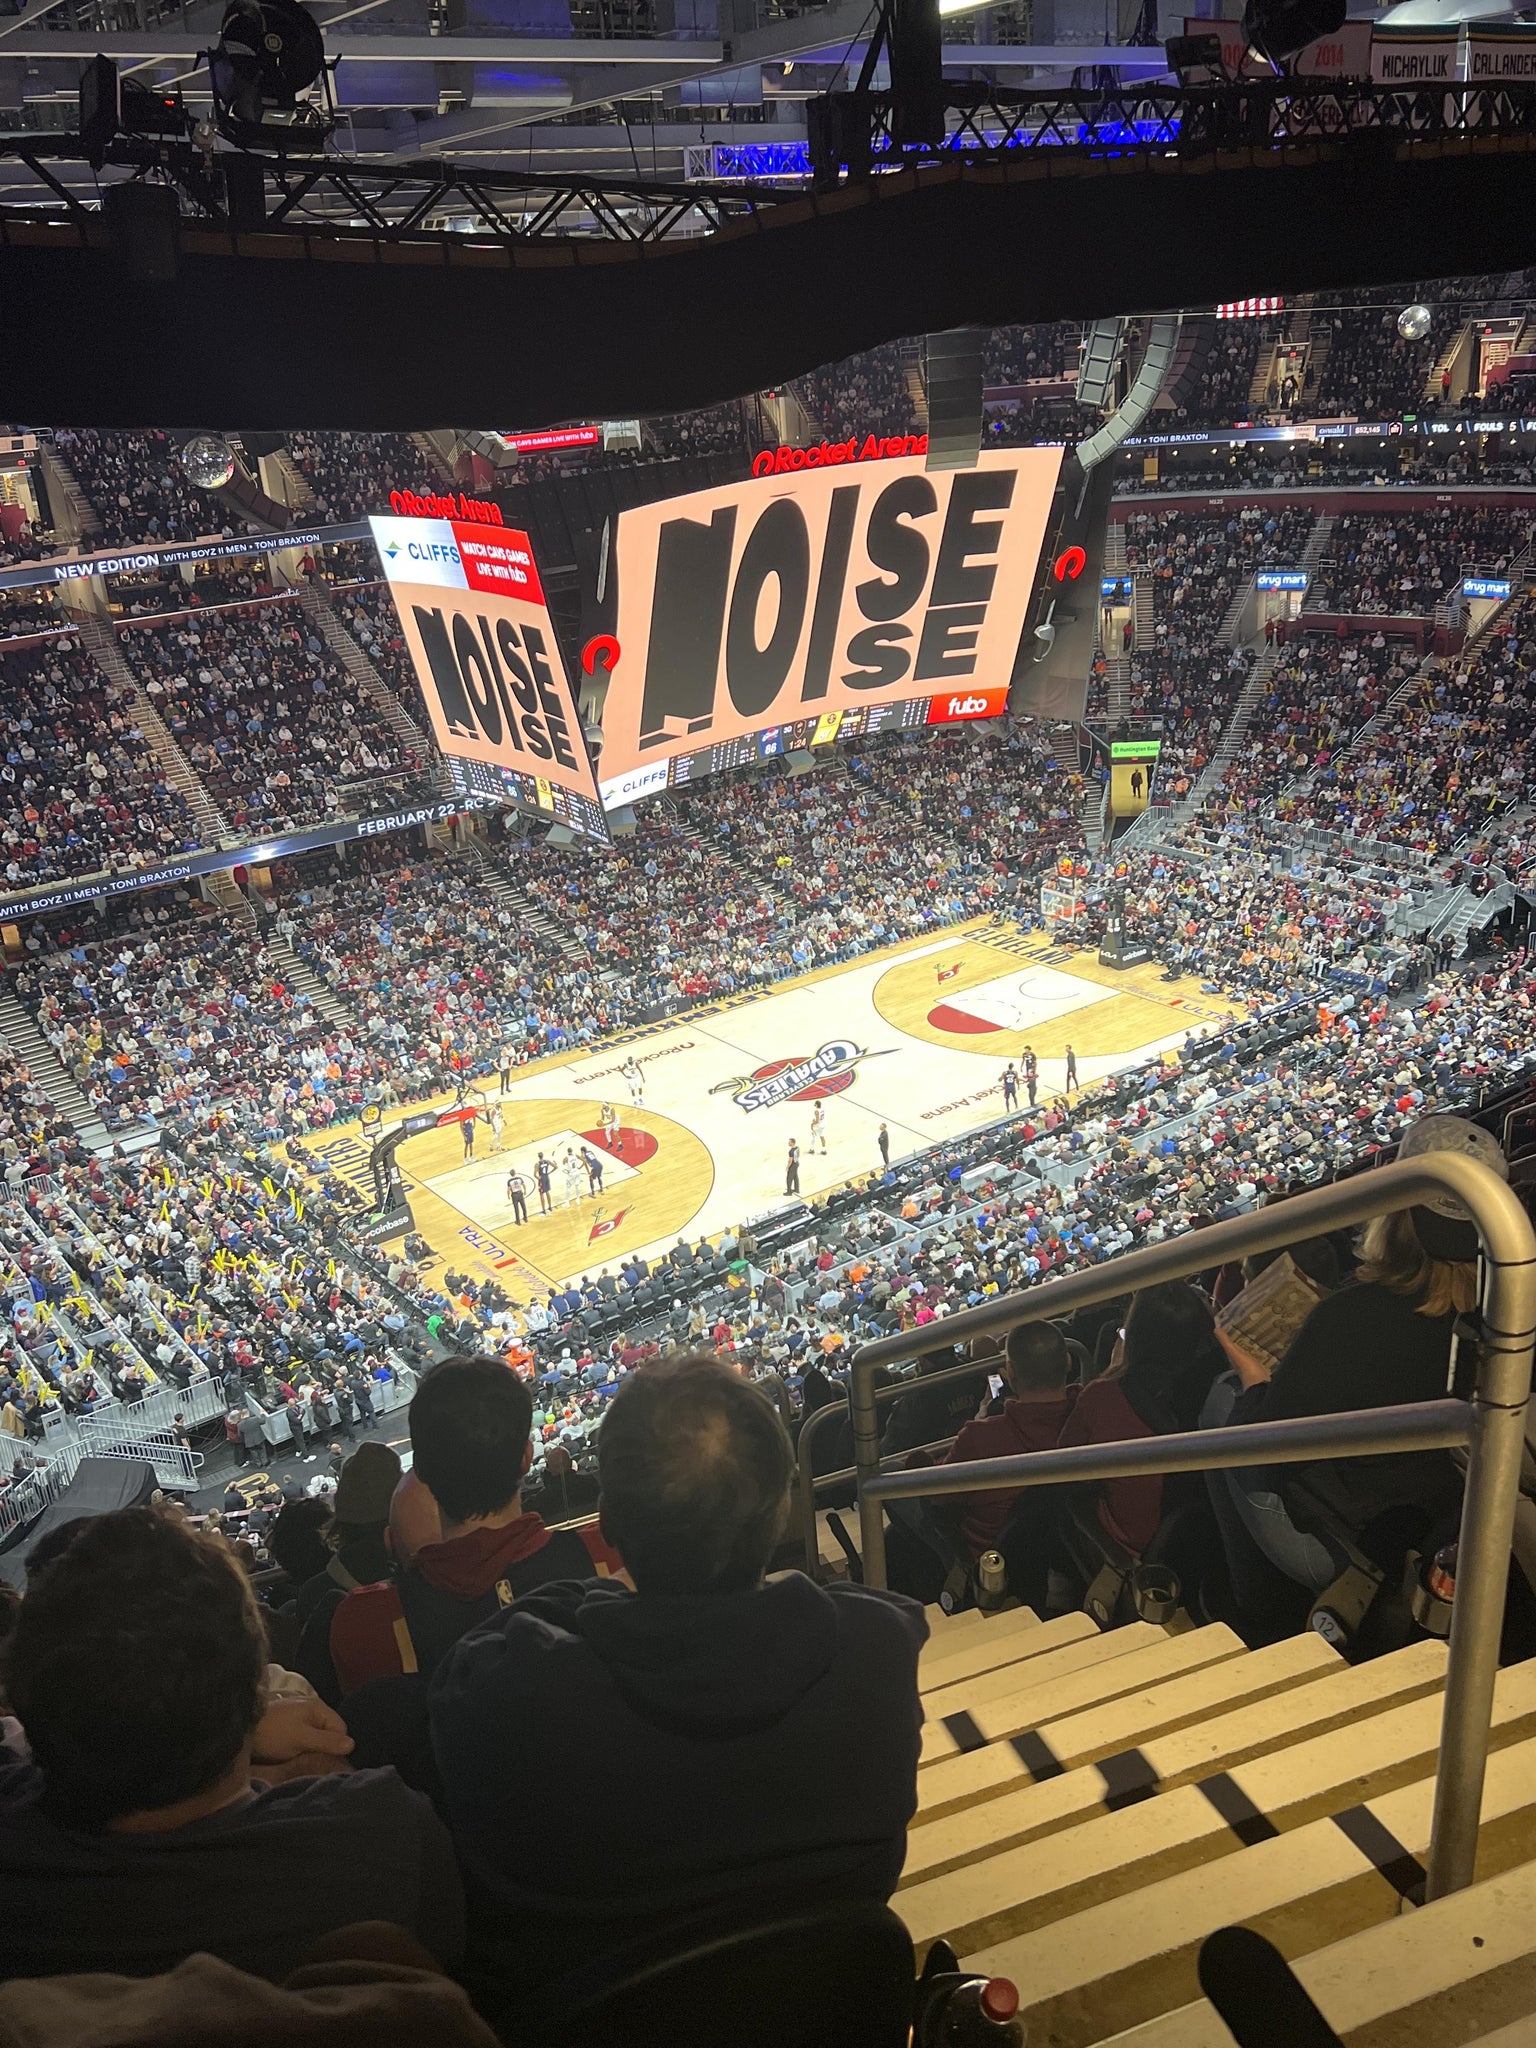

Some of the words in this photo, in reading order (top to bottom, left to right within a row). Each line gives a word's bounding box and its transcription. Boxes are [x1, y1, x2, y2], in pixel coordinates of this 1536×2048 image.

[1382, 54, 1449, 78] MICHAYLUK
[1474, 52, 1536, 75] CALLANDER
[1432, 423, 1450, 433] TOL
[1455, 423, 1463, 432] 4
[1473, 421, 1504, 432] FOULS
[1509, 421, 1517, 431] 5
[1149, 436, 1169, 444] TONI
[1170, 433, 1209, 443] BRAXTON
[775, 437, 859, 474] Rocket
[859, 433, 929, 462] Arena
[403, 489, 460, 519] Rocket
[460, 492, 504, 525] Arena
[55, 560, 95, 579] NEW
[98, 554, 161, 574] EDITION
[163, 550, 190, 563] WITH
[191, 547, 218, 559] BOYZ
[226, 543, 248, 554] MEN
[254, 539, 277, 550] TONI
[278, 534, 320, 548] BRAXTON
[407, 542, 461, 564] CLIFFS
[461, 541, 487, 555] WATCH
[487, 545, 506, 561] CAVS
[505, 549, 530, 566] GAMES
[476, 562, 493, 576] LIVE
[493, 566, 509, 580] WITH
[509, 566, 528, 584] fubo
[1258, 573, 1281, 587] drug
[1283, 573, 1307, 584] mart
[1464, 581, 1486, 594] drug
[1487, 583, 1510, 593] mart
[948, 695, 987, 716] fubo
[623, 768, 667, 794] CLIFFS
[358, 807, 436, 836] FEBRUARY
[437, 803, 456, 818] 22
[0, 901, 29, 918] WITH
[31, 894, 62, 910] BOYZ
[73, 886, 102, 901] MEN
[109, 877, 138, 892] TONI
[139, 866, 191, 886] BRAXTON
[962, 927, 1075, 965] CLEVELAND
[1122, 948, 1147, 962] coinbase
[725, 989, 775, 1009] LET
[630, 1046, 683, 1066] Rocke
[735, 1040, 867, 1113] CAVALIERS
[919, 1098, 970, 1121] Arena
[314, 1137, 415, 1193] VALIERS
[369, 1215, 409, 1237] coinbase
[457, 1225, 506, 1261] ULTRA
[1318, 1616, 1335, 1638] 12
